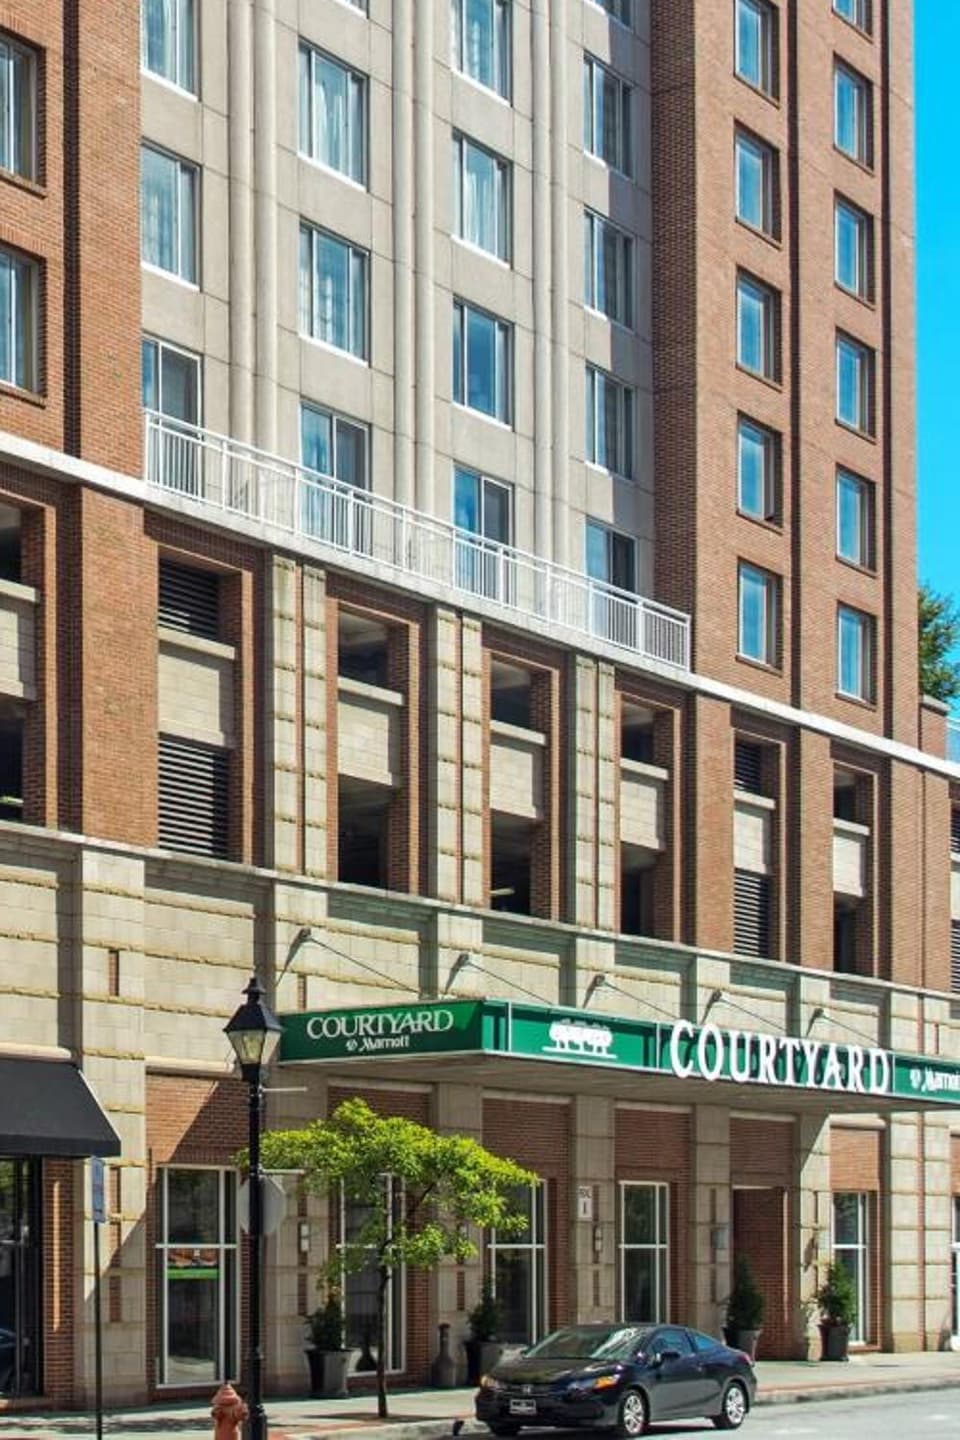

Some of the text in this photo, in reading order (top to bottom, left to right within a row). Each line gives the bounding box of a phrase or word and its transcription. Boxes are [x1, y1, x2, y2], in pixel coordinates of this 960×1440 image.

[306, 1009, 454, 1039] COURTYARD
[359, 1035, 410, 1052] Marriott
[670, 1019, 890, 1094] COURTYARD
